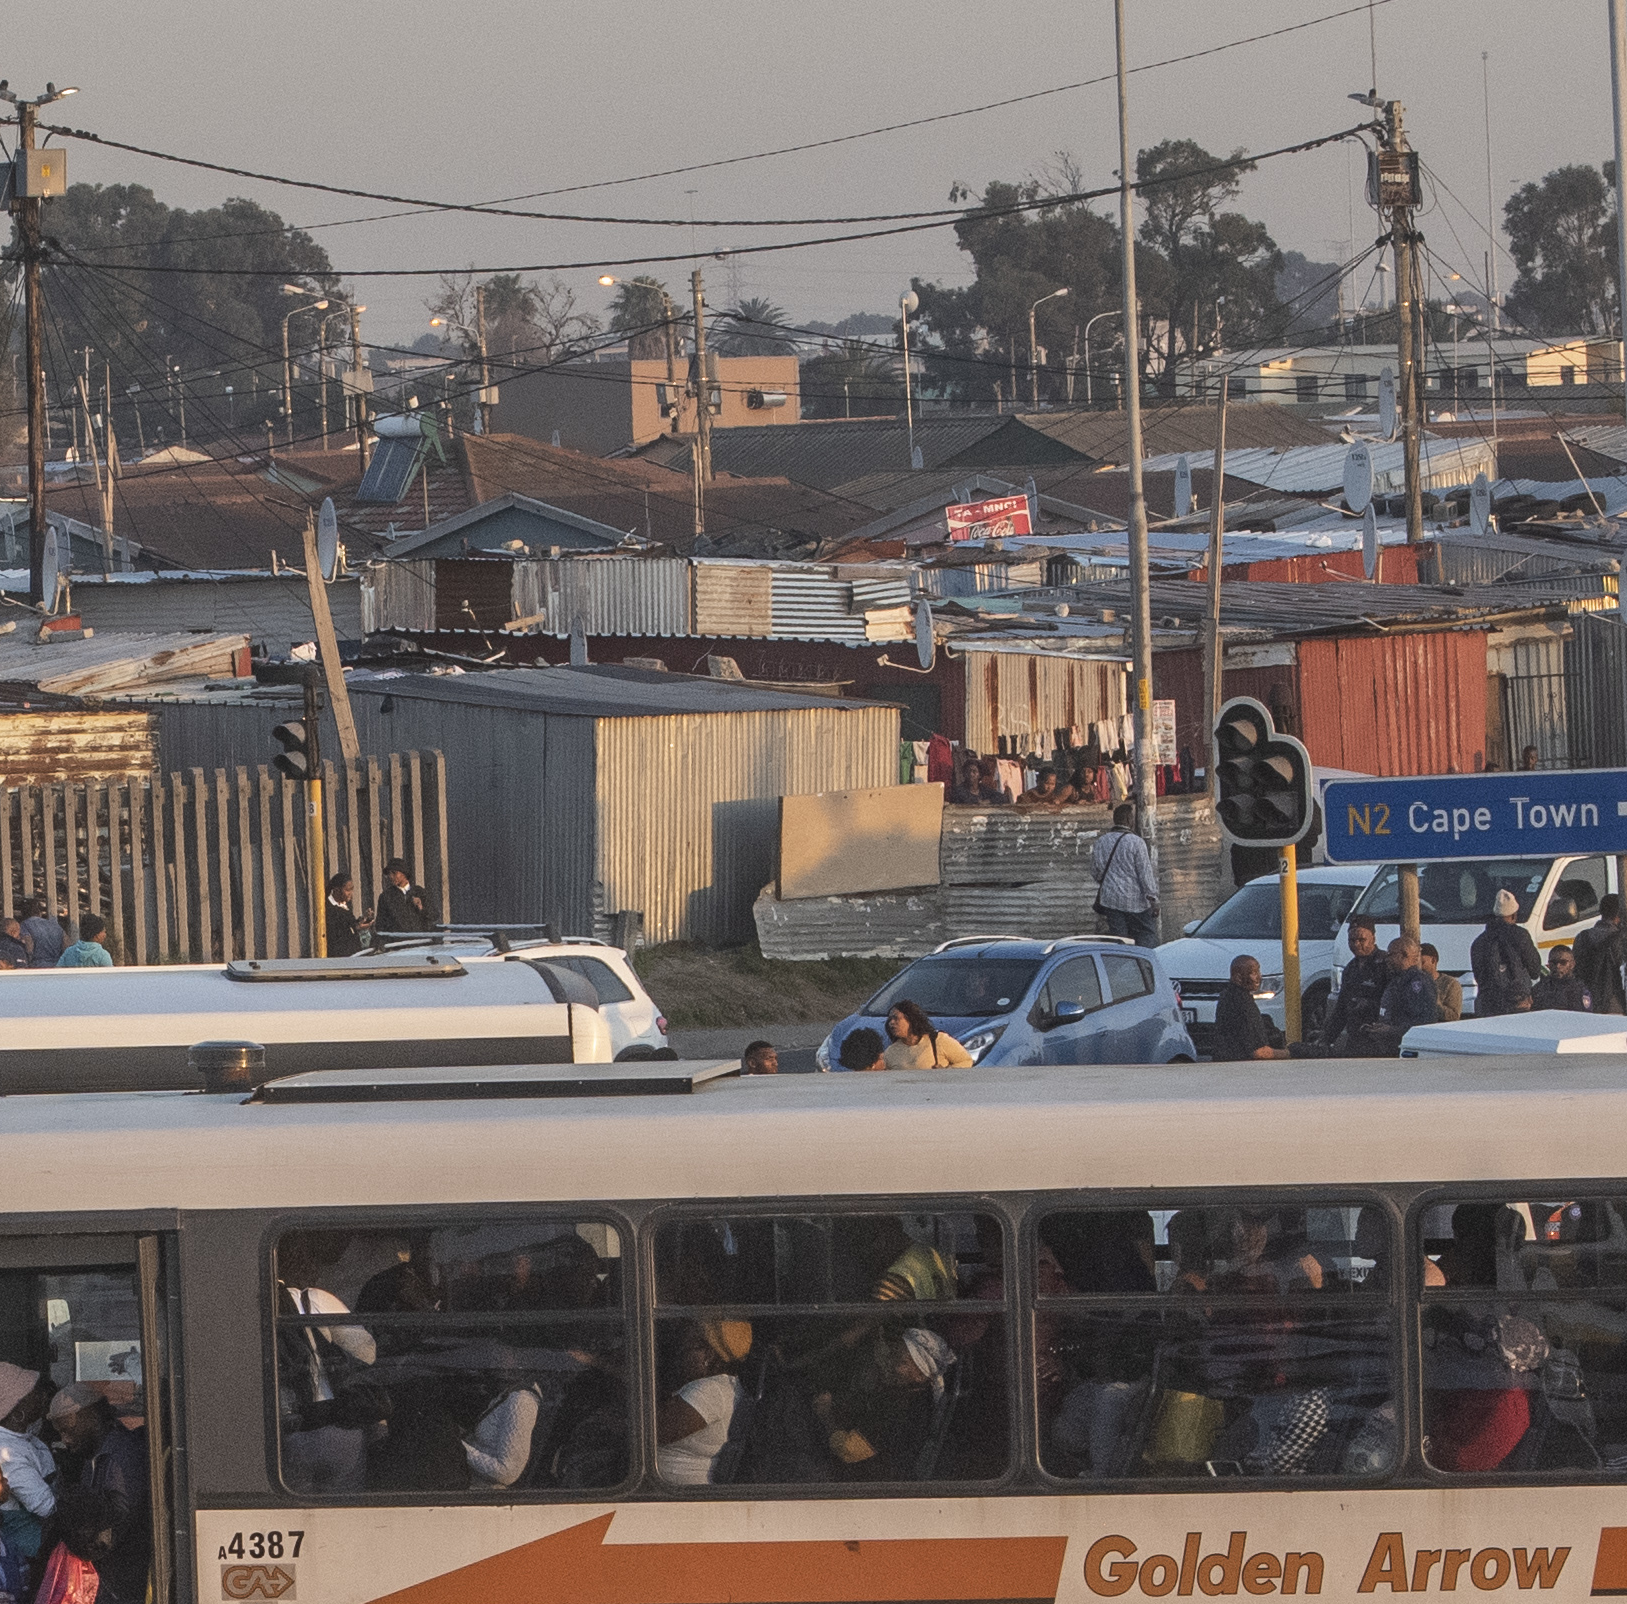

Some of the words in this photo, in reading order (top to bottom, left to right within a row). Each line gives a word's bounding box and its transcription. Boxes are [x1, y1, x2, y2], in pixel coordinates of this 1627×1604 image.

[1347, 804, 1391, 837] N2
[1407, 800, 1493, 841] Cape
[1509, 796, 1600, 830] Town
[1281, 860, 1289, 874] 2
[1082, 1531, 1325, 1598] Golden
[1357, 1532, 1572, 1593] Arrow
